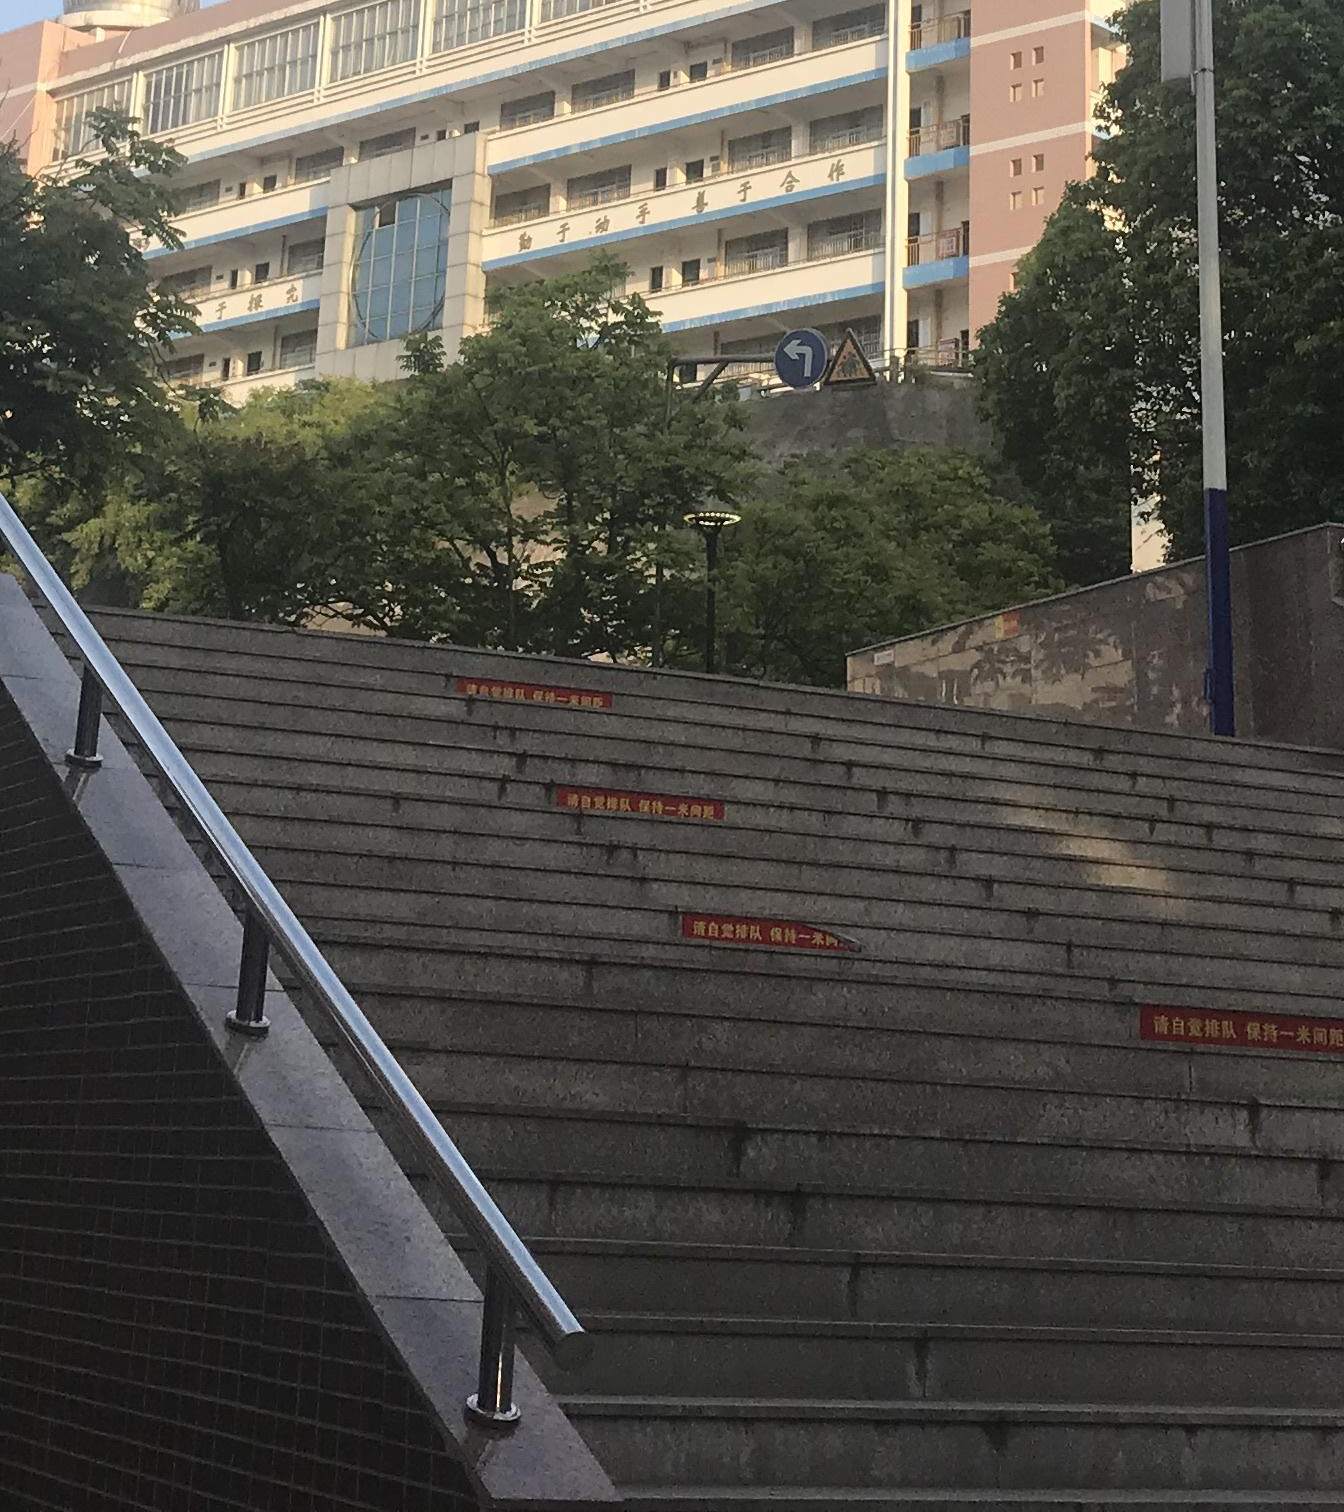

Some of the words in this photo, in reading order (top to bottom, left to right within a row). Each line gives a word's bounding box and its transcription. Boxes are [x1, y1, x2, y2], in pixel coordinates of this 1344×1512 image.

[693, 920, 762, 940] 请自觉排队
[770, 927, 843, 948] 保持一米间
[1153, 1014, 1237, 1039] 请自觉排队
[1246, 1022, 1344, 1048] 保持一米间距
